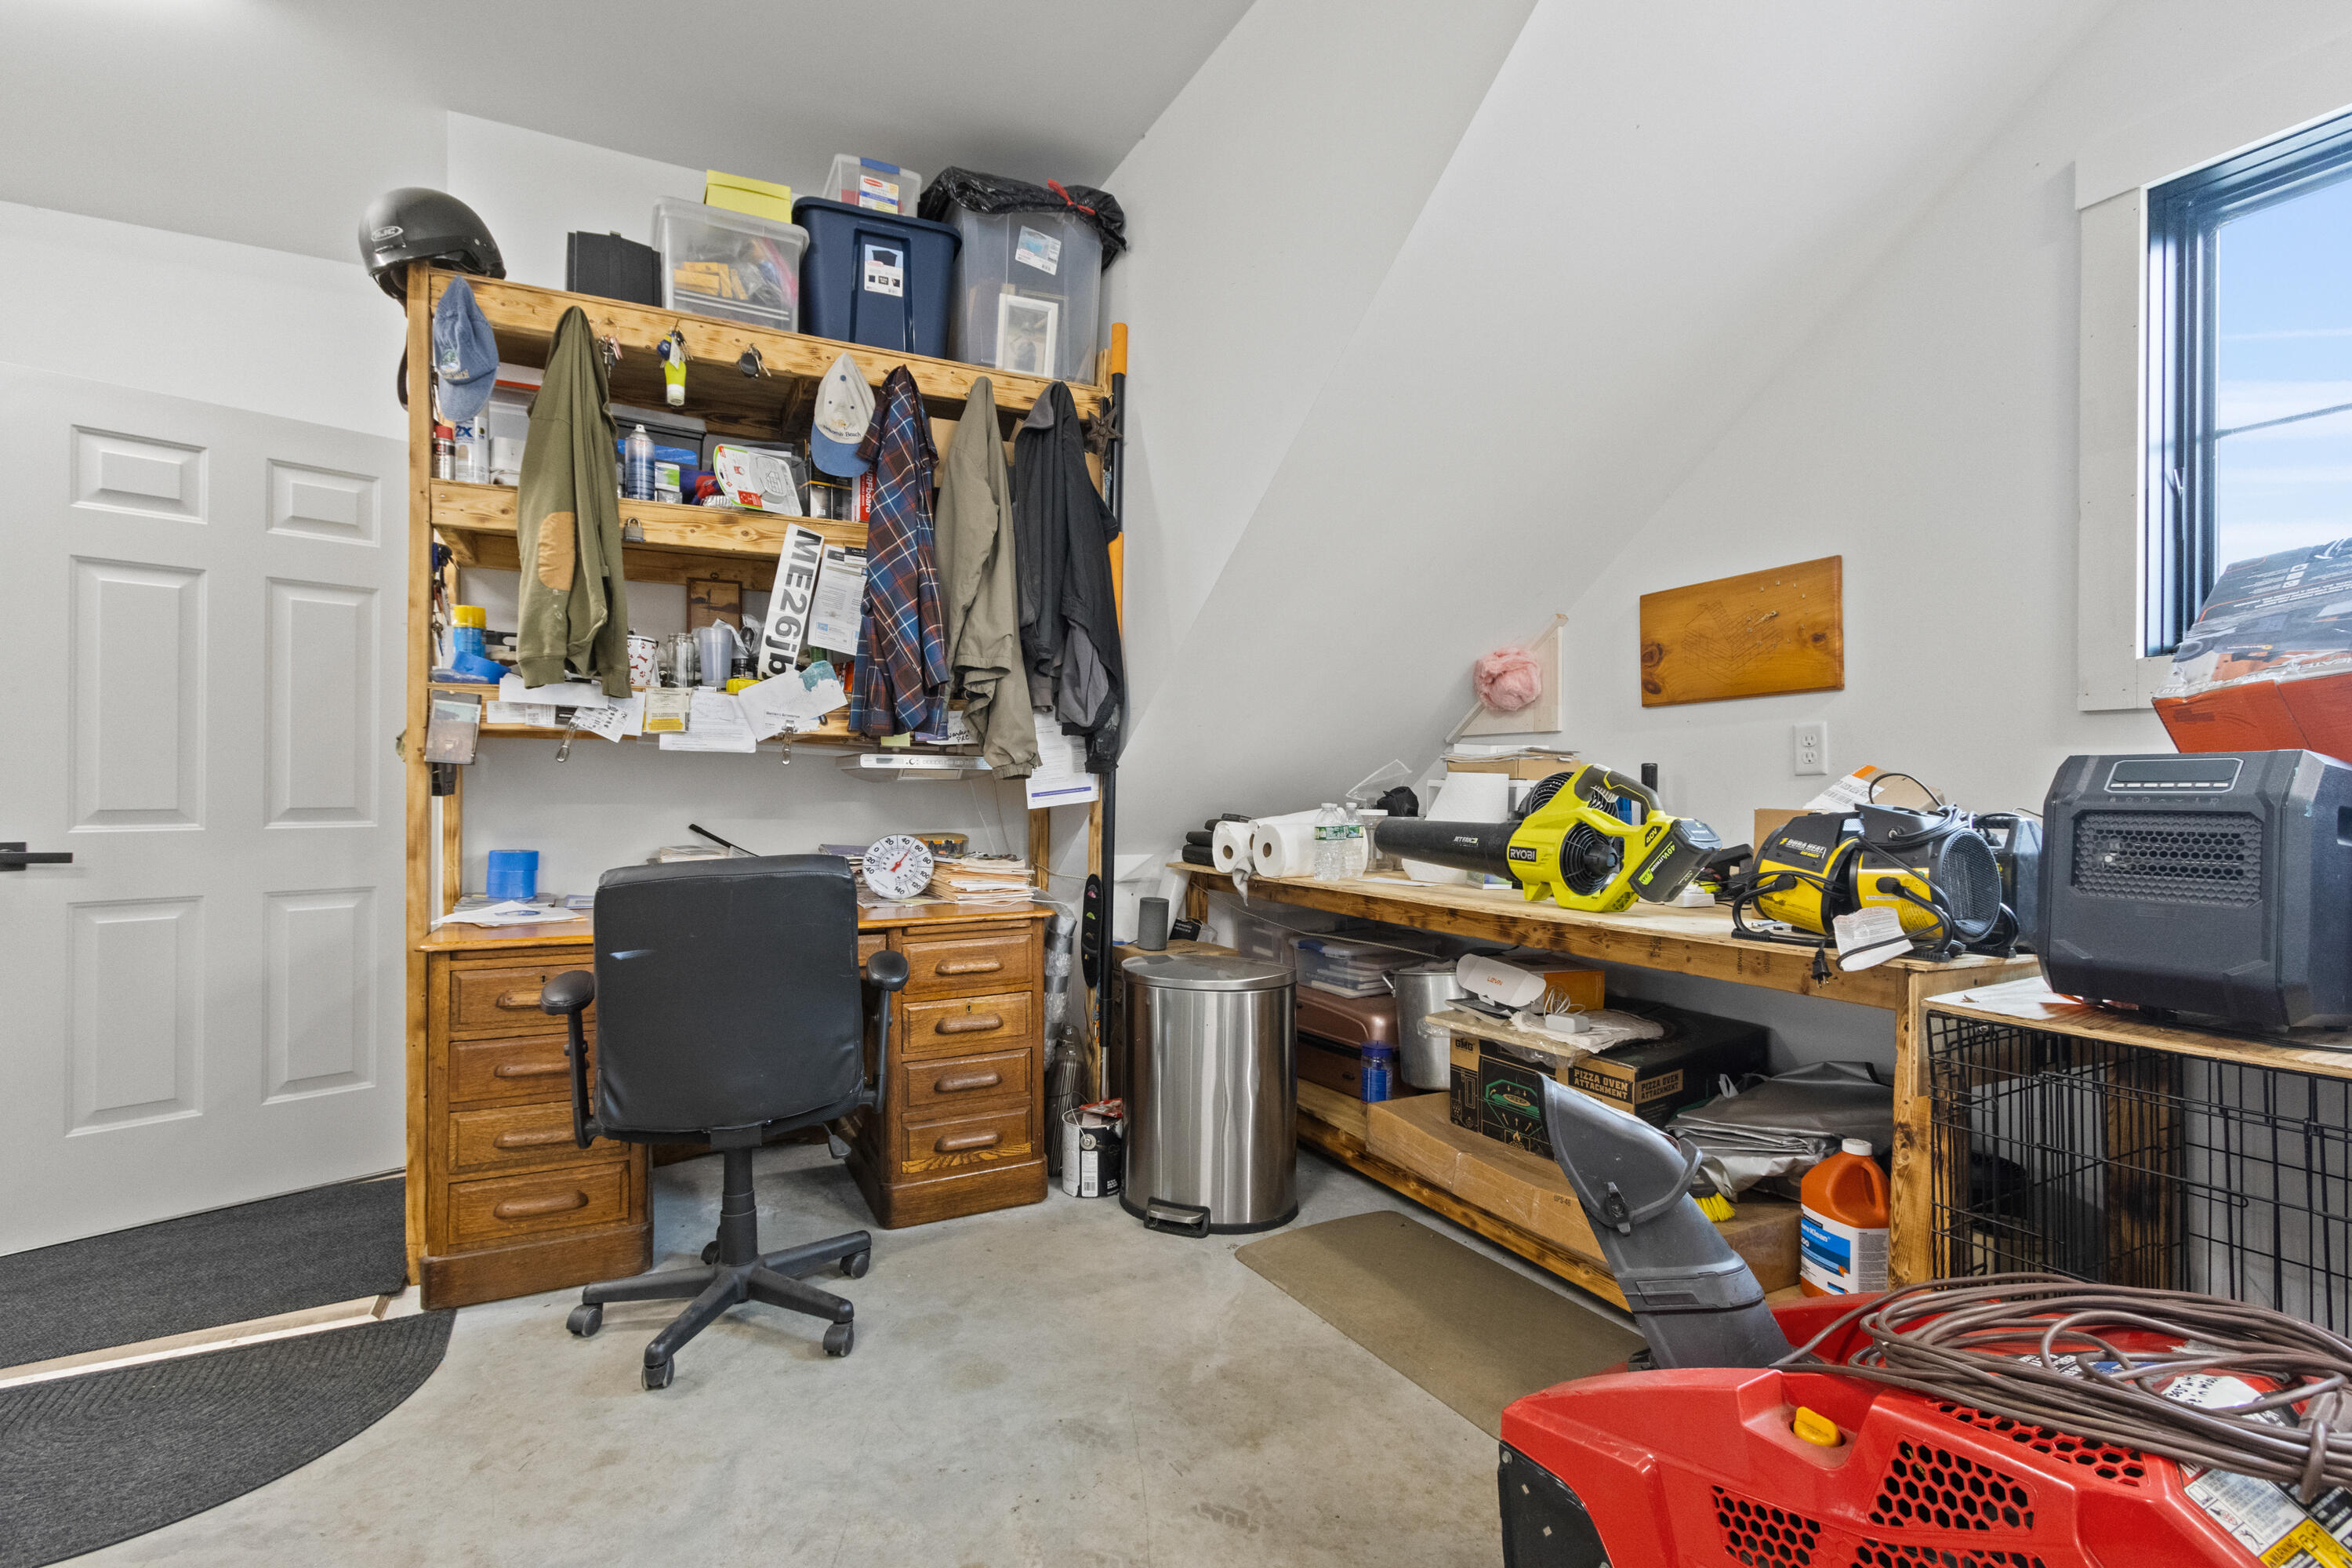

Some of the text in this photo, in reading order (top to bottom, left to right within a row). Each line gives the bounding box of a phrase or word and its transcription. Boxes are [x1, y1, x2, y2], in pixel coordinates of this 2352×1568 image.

[885, 837, 895, 846] 20
[1646, 827, 1658, 844] 40V
[1510, 848, 1535, 861] RYOBI
[1664, 844, 1675, 860] 40V
[922, 856, 931, 865] 80
[920, 870, 930, 880] 100
[895, 886, 905, 895] 140
[911, 881, 921, 890] 120
[1455, 1038, 1474, 1051] GMG
[1573, 1069, 1629, 1091] PIZZA OVEN
[1642, 1073, 1679, 1092] PIZZA OVEN
[1573, 1078, 1628, 1100] ATTACHMENT
[1641, 1082, 1679, 1100] ATTACHMENT
[1809, 1225, 1828, 1243] Klean
[1801, 1236, 1810, 1247] 00
[2272, 1537, 2300, 1568] WARNING
